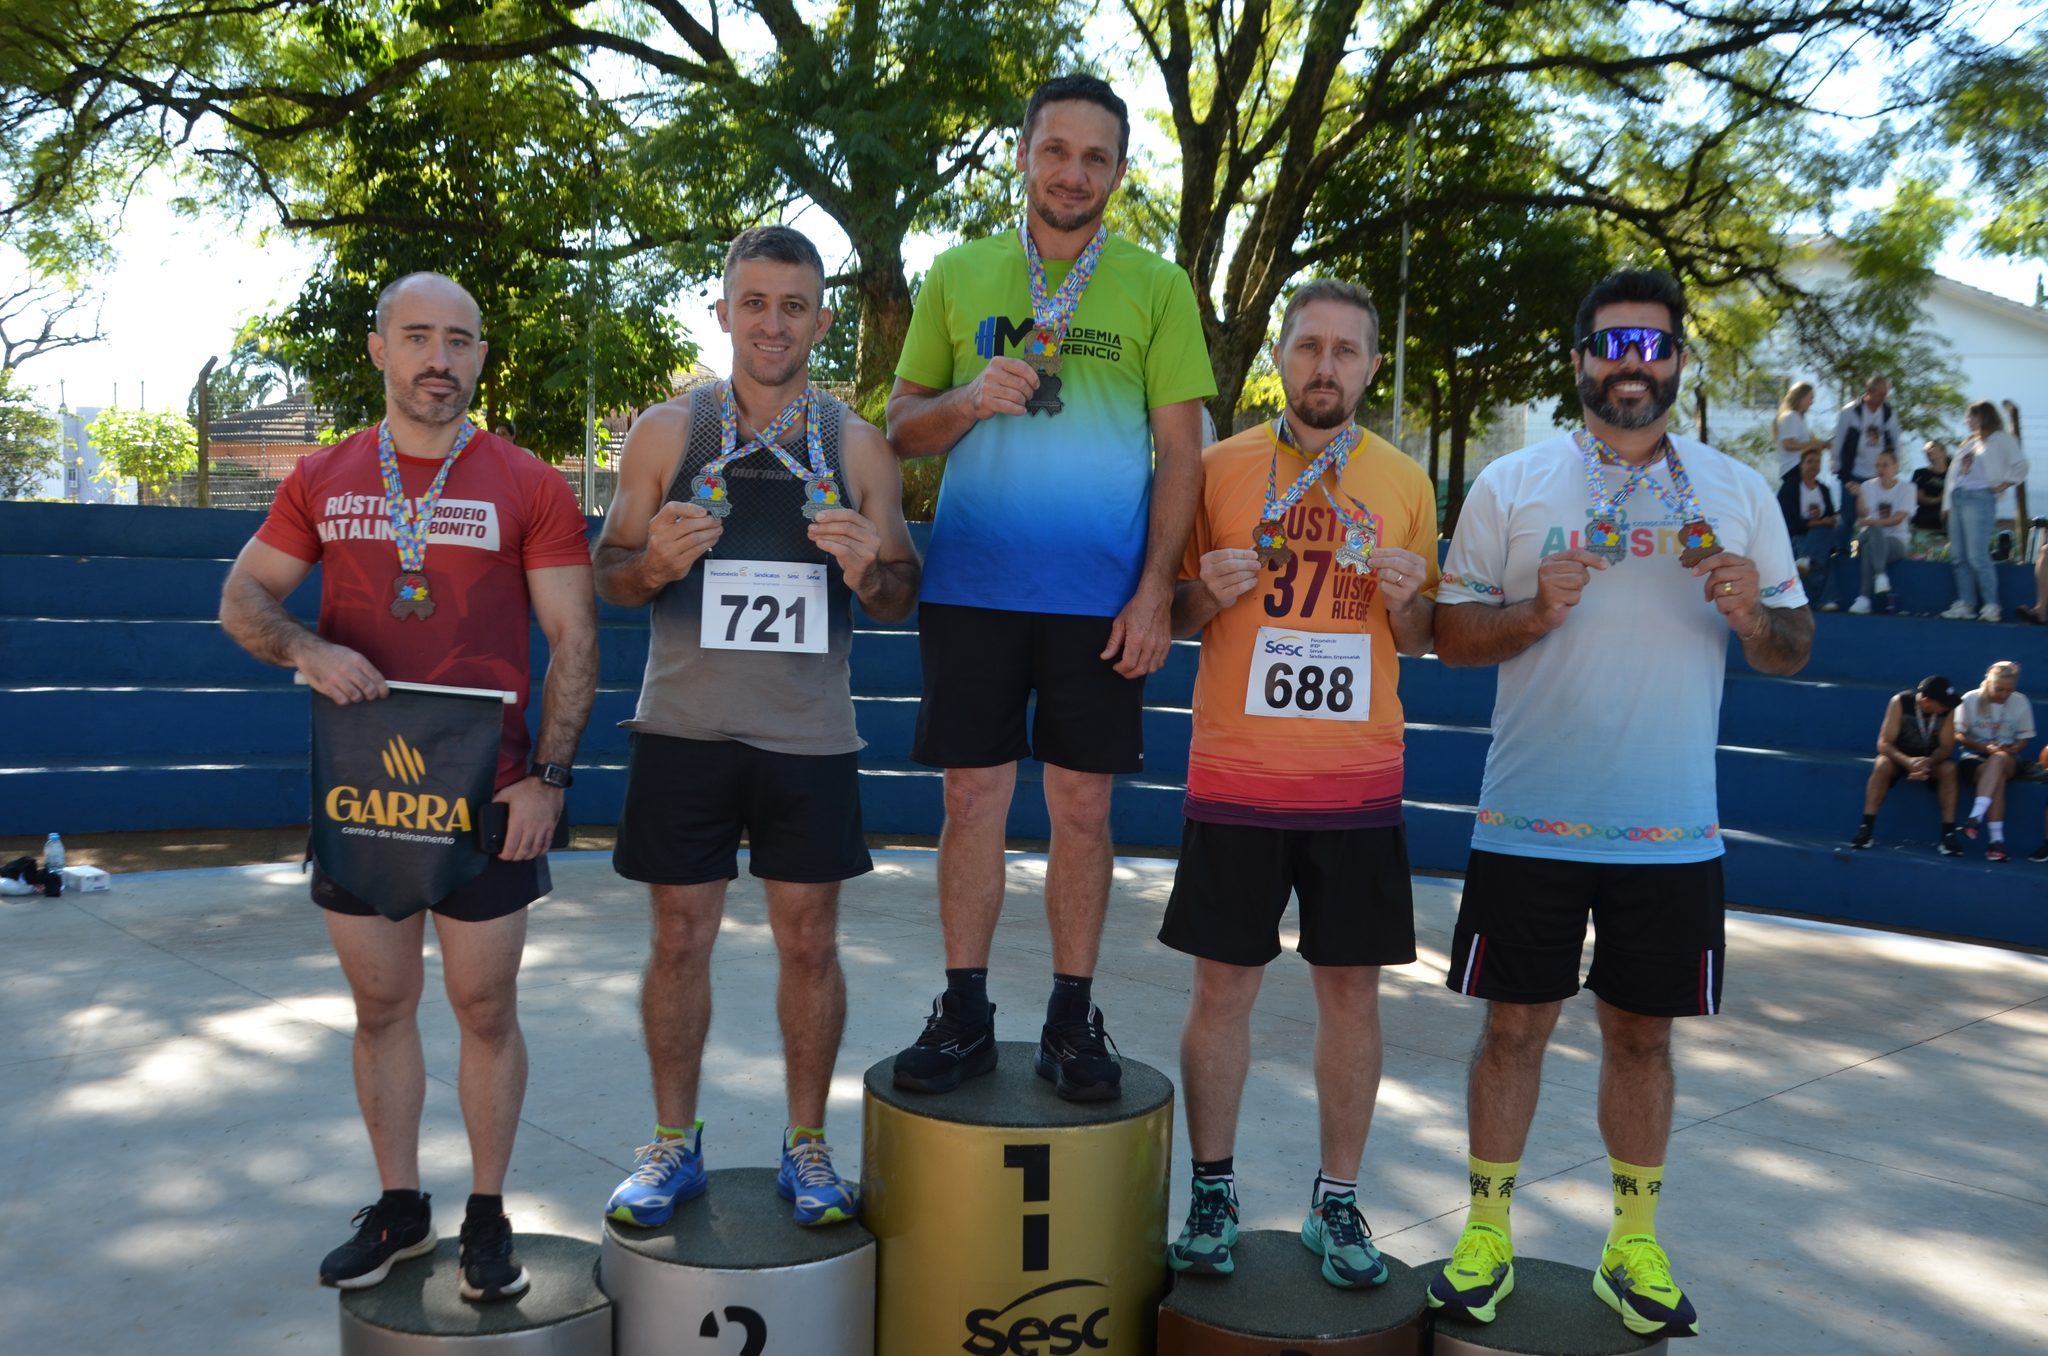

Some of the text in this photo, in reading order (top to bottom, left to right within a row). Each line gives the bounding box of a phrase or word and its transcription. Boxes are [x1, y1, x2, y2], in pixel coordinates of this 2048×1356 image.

[1064, 327, 1121, 345] ADEMIA
[1060, 344, 1120, 362] RENCIO
[432, 506, 487, 522] RODEIO
[317, 519, 397, 543] NATALIN
[429, 522, 487, 539] BONITO
[1264, 549, 1332, 618] 37
[1333, 575, 1377, 603] VISTA
[720, 594, 806, 644] 721
[1264, 640, 1304, 657] Sesc
[1264, 662, 1354, 713] 688
[325, 785, 473, 833] GARRA
[341, 826, 456, 845] centro de treinamento
[1003, 1144, 1050, 1272] 1
[962, 1307, 1109, 1356] Sesc
